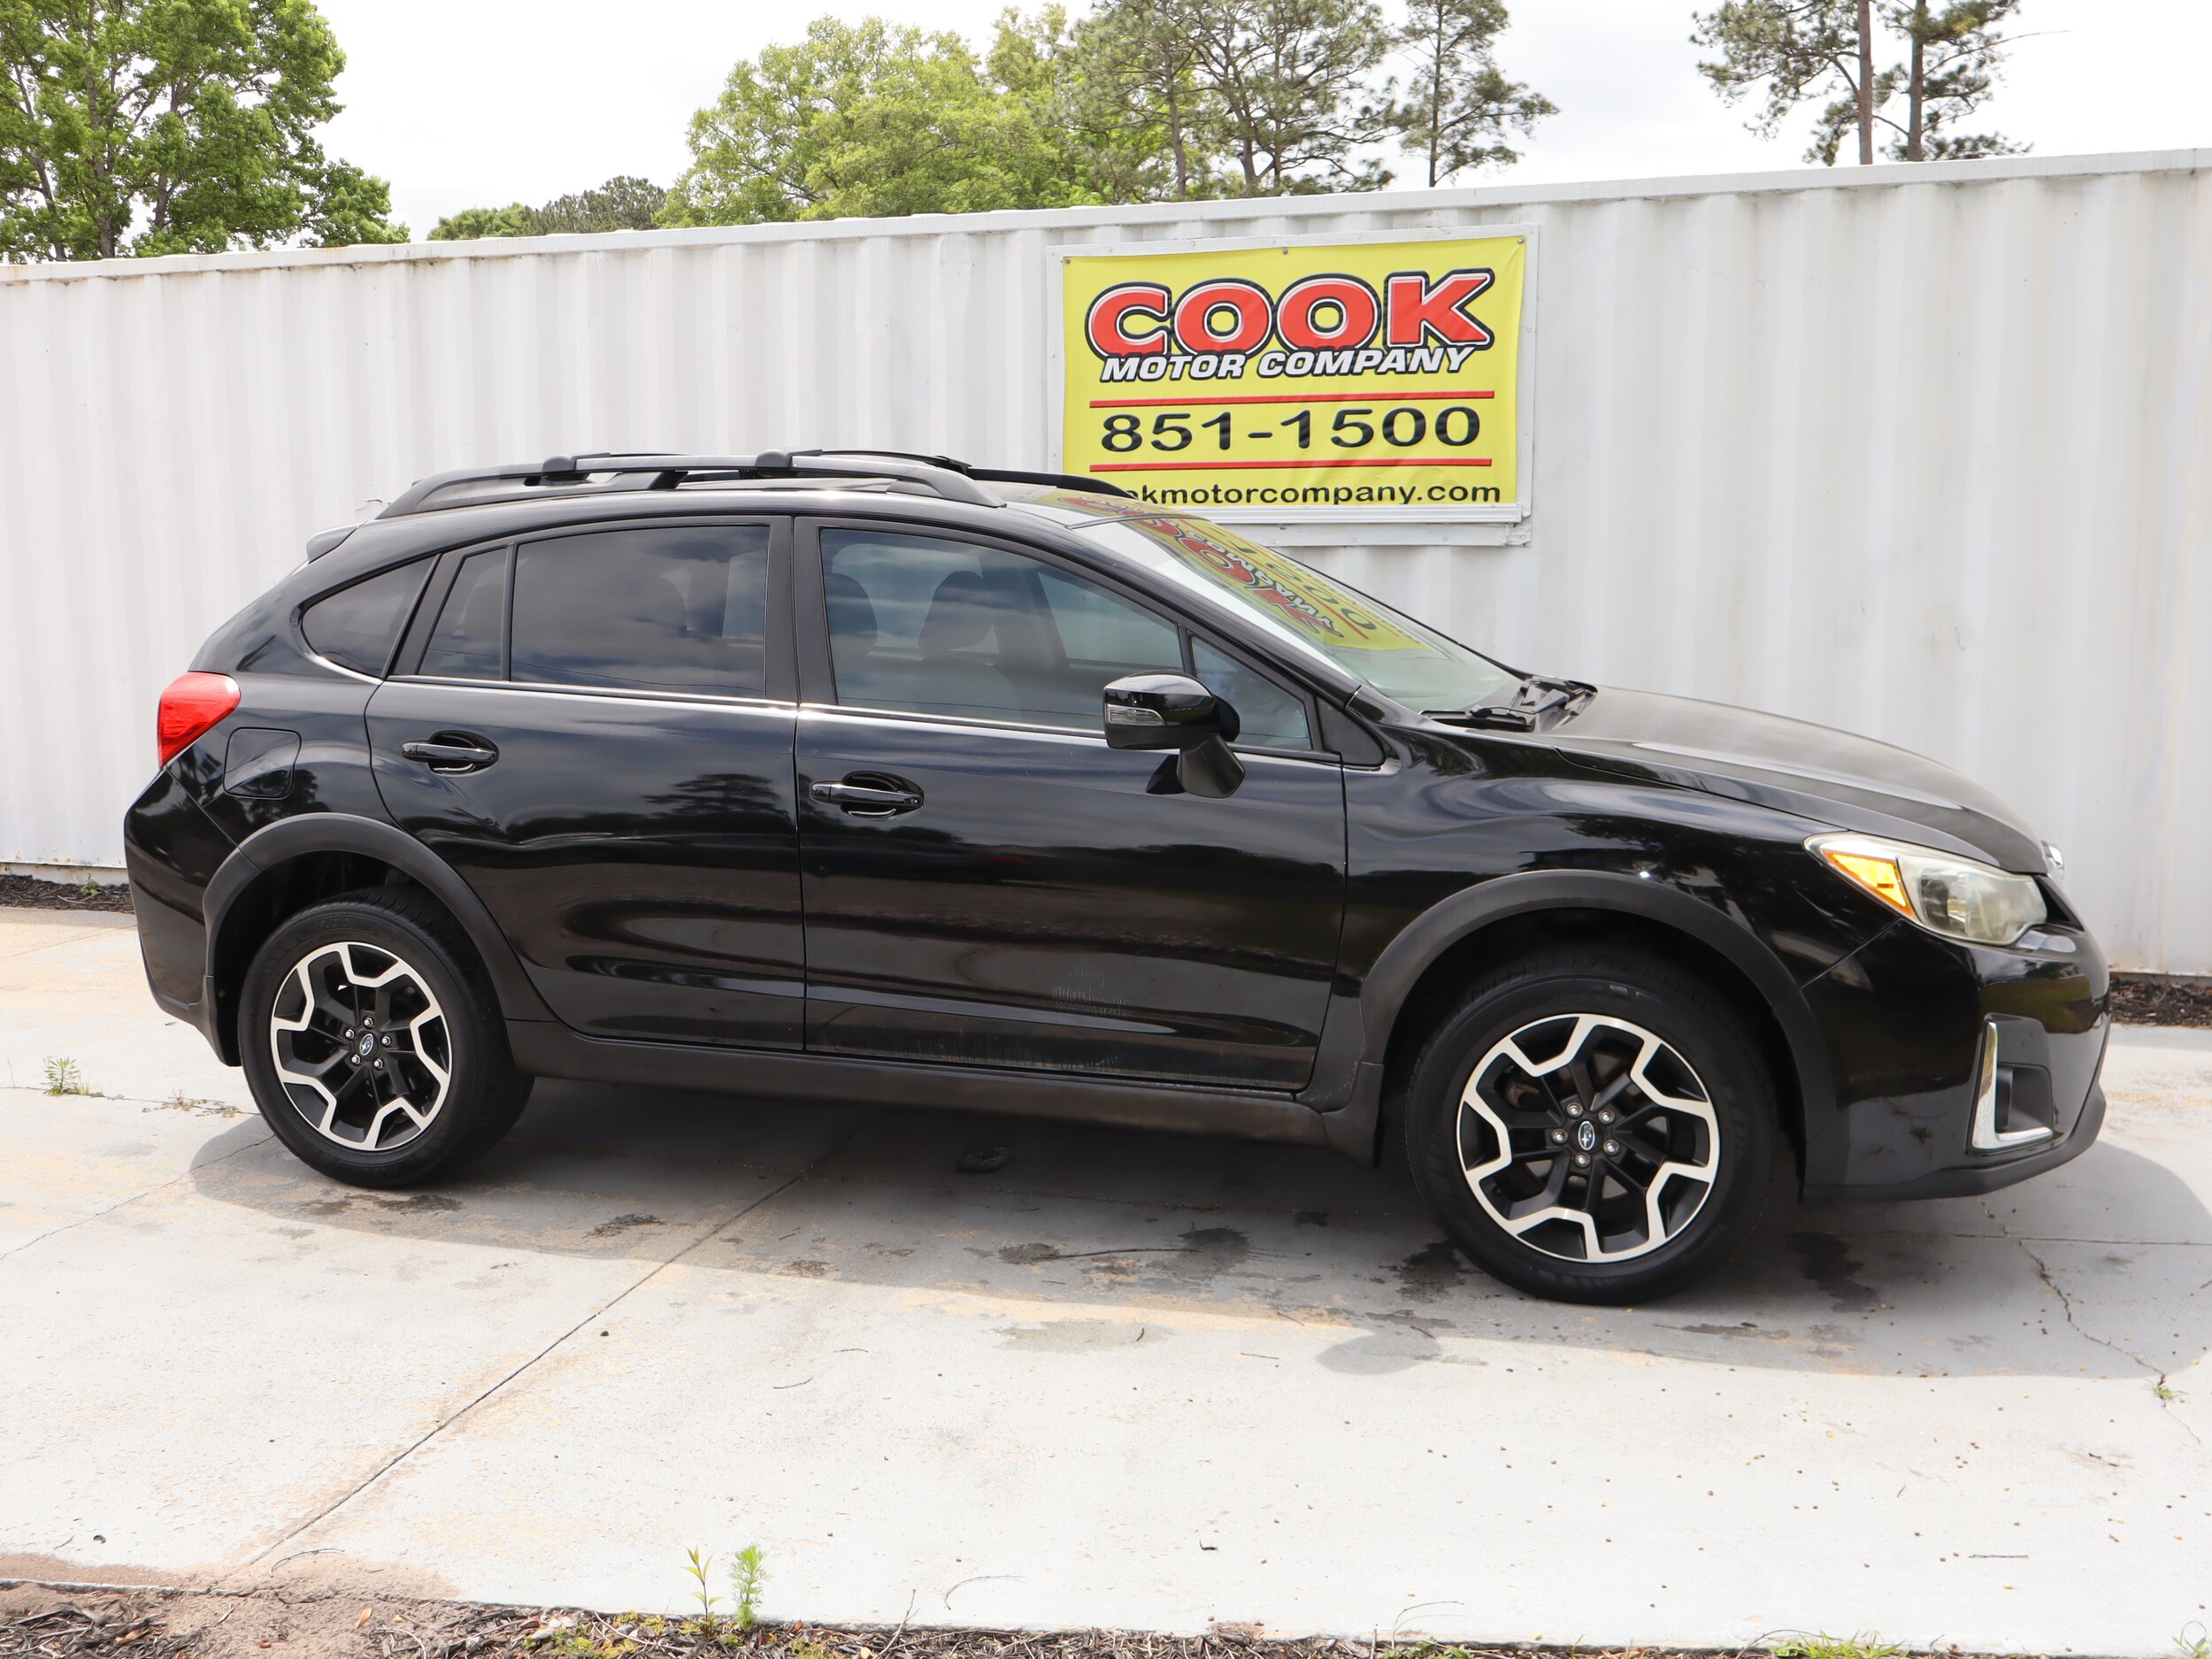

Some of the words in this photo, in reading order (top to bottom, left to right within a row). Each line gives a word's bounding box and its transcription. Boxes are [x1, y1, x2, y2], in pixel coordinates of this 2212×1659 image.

[1086, 268, 1495, 359] COOK
[1100, 351, 1247, 383] MOTOR
[1257, 347, 1476, 378] COMPANY
[1101, 407, 1480, 452] 851-1500
